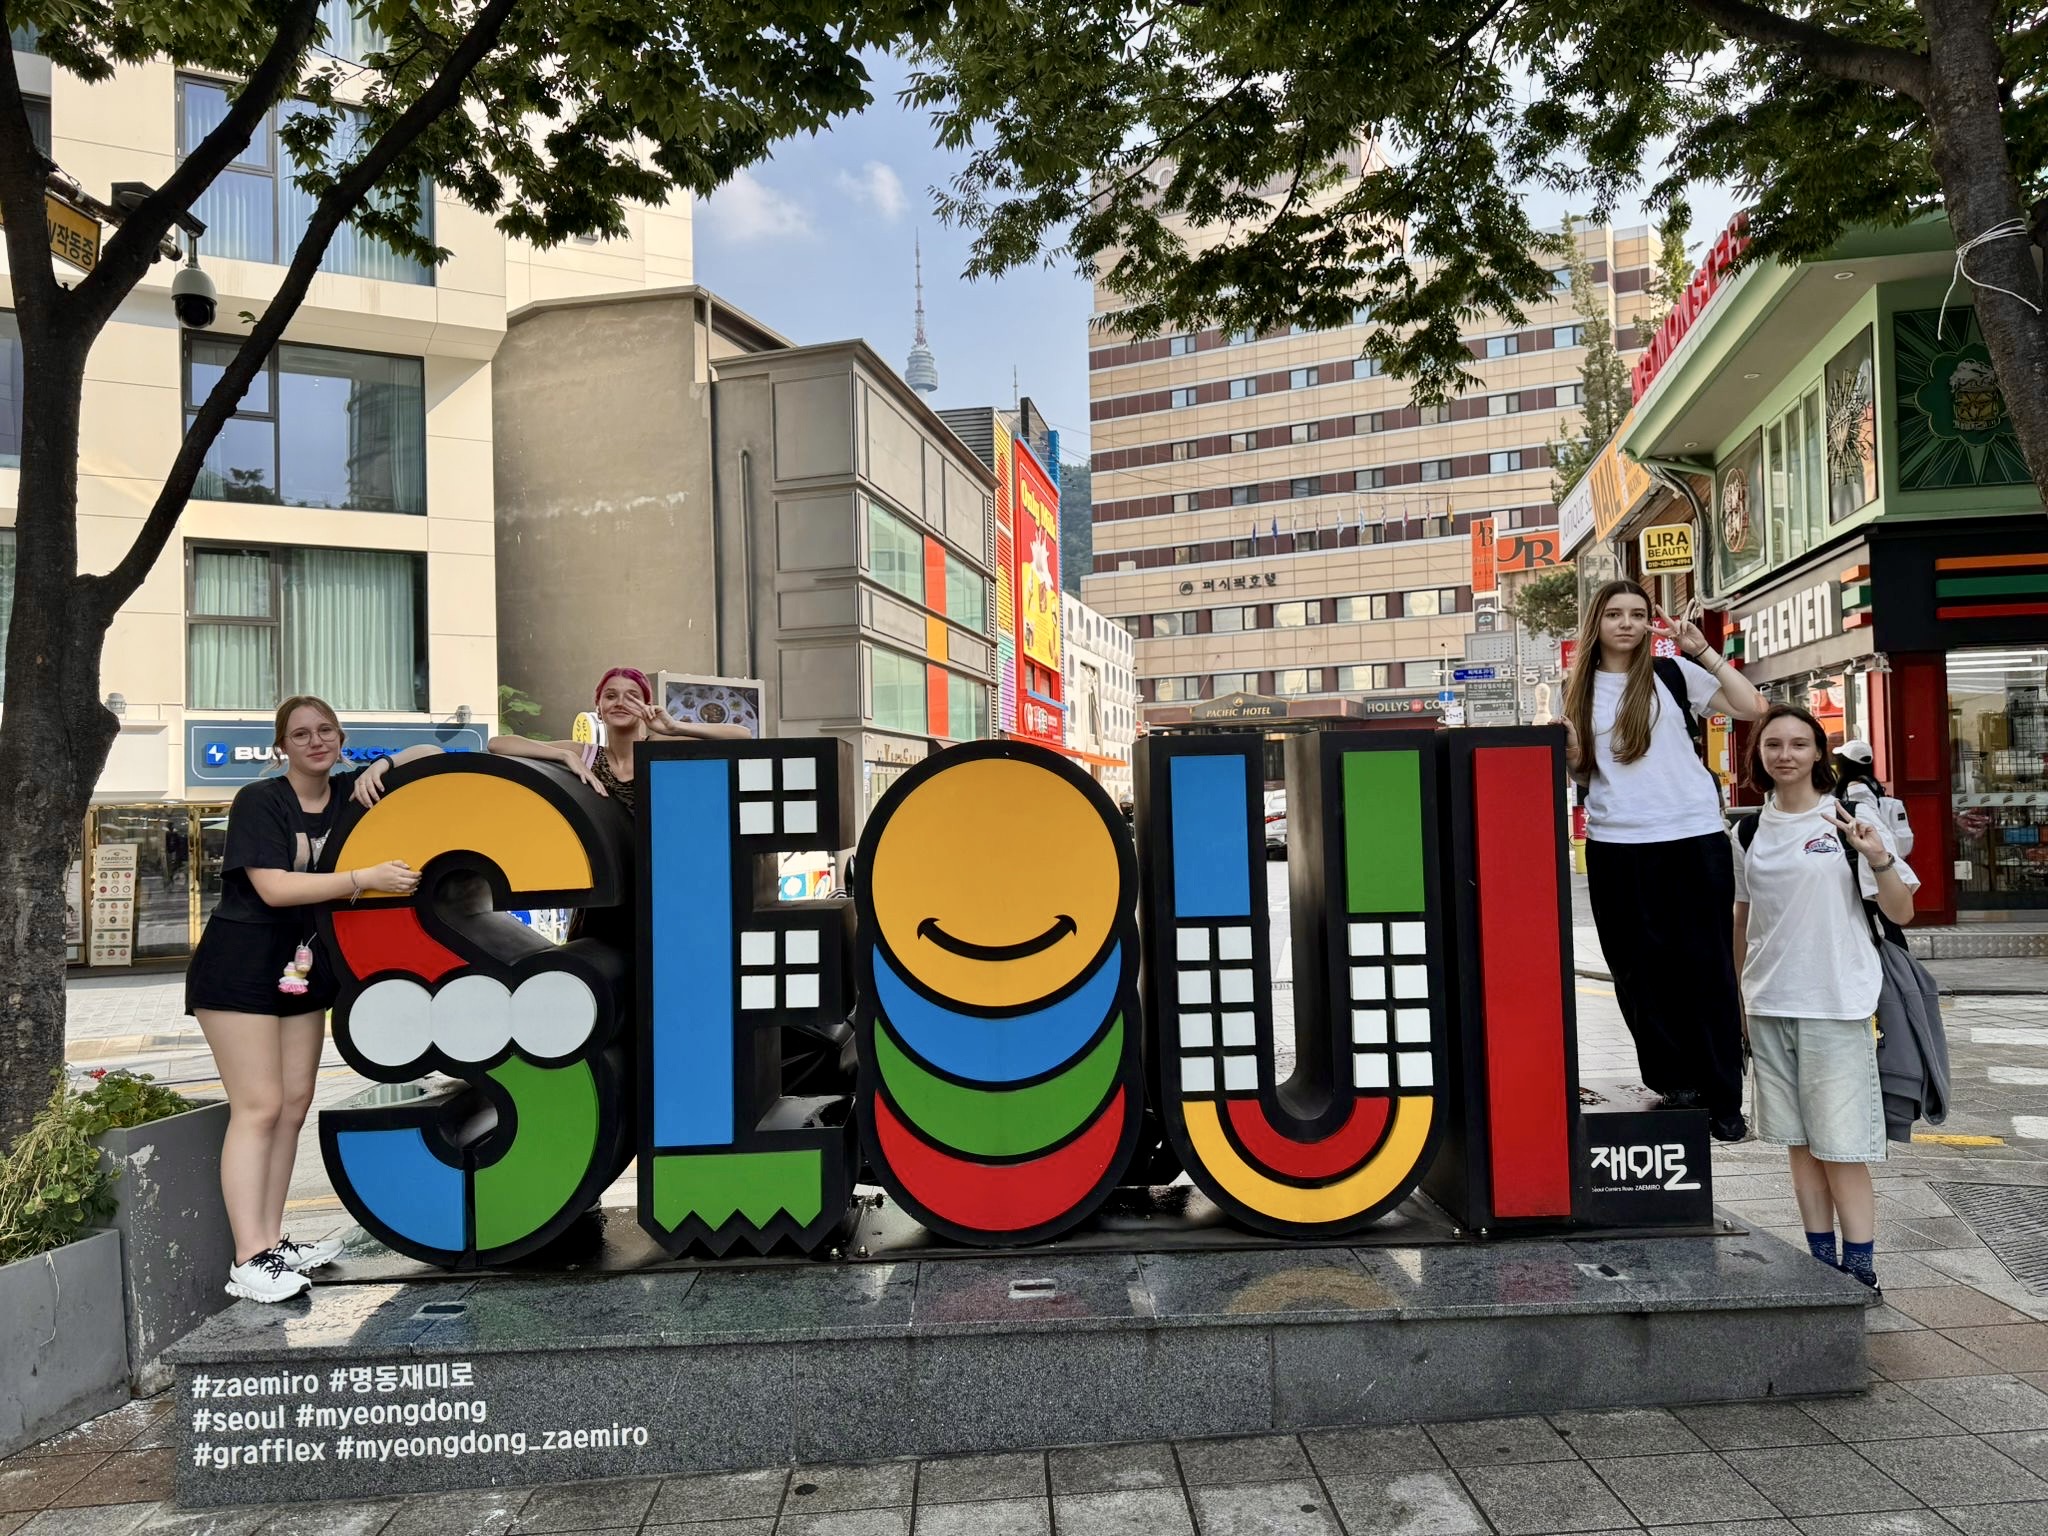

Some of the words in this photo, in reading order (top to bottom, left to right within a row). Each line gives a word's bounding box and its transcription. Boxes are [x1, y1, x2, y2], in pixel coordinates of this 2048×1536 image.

[1590, 454, 1621, 537] NAIL
[1647, 531, 1689, 548] LIRA
[1648, 546, 1689, 558] BEAUTY
[1206, 708, 1239, 718] PACIFIC
[1242, 706, 1271, 716] HOTEL
[1367, 700, 1410, 713] HOLLYS
[1590, 1143, 1702, 1191] 재미로
[191, 1370, 319, 1399] #zaemiro
[329, 1362, 475, 1393] #명동재미로
[192, 1405, 285, 1433] #seoul
[295, 1398, 487, 1430] #myeongdong
[192, 1437, 326, 1469] #grafflex
[335, 1422, 649, 1462] #myeongdong_zaemiro
